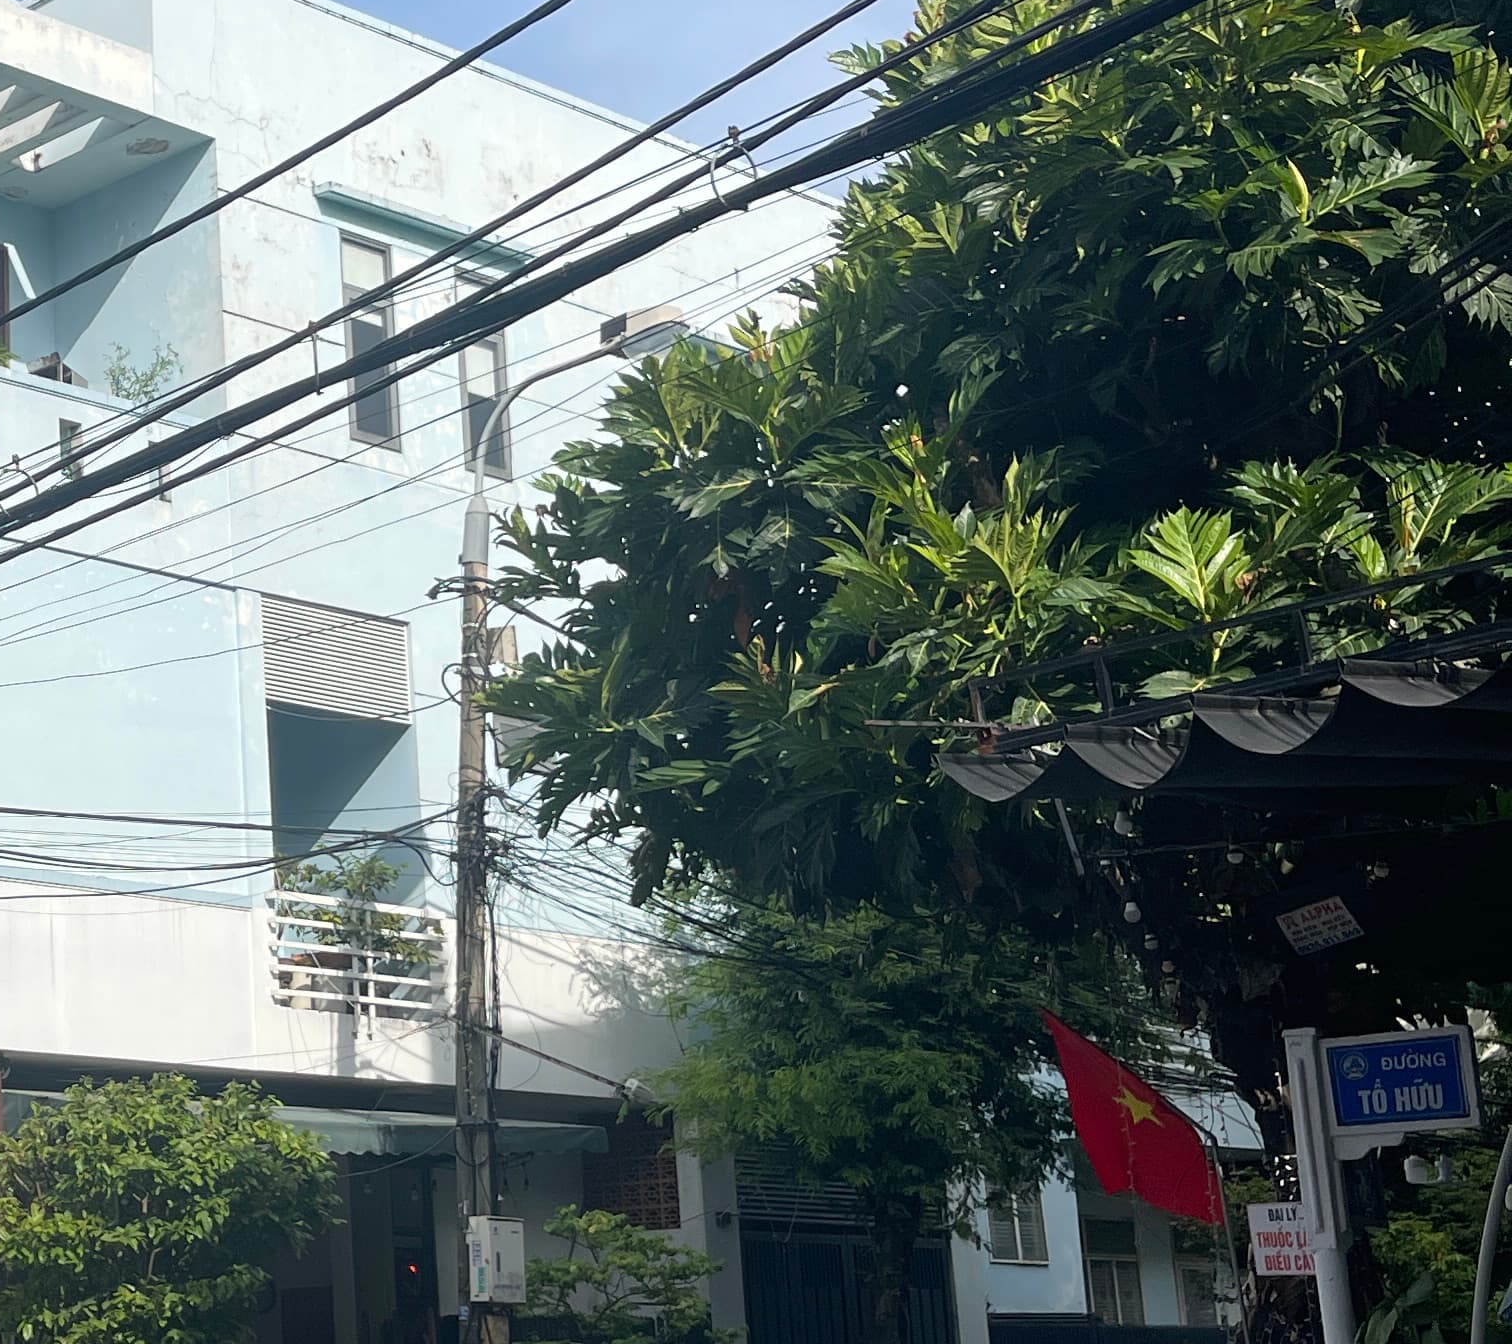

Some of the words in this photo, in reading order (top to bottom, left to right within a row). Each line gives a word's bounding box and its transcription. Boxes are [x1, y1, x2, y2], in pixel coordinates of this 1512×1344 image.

[1381, 1049, 1446, 1071] ĐƯỜNG
[1395, 1078, 1444, 1112] HỮU
[1256, 1225, 1294, 1248] THUỐC
